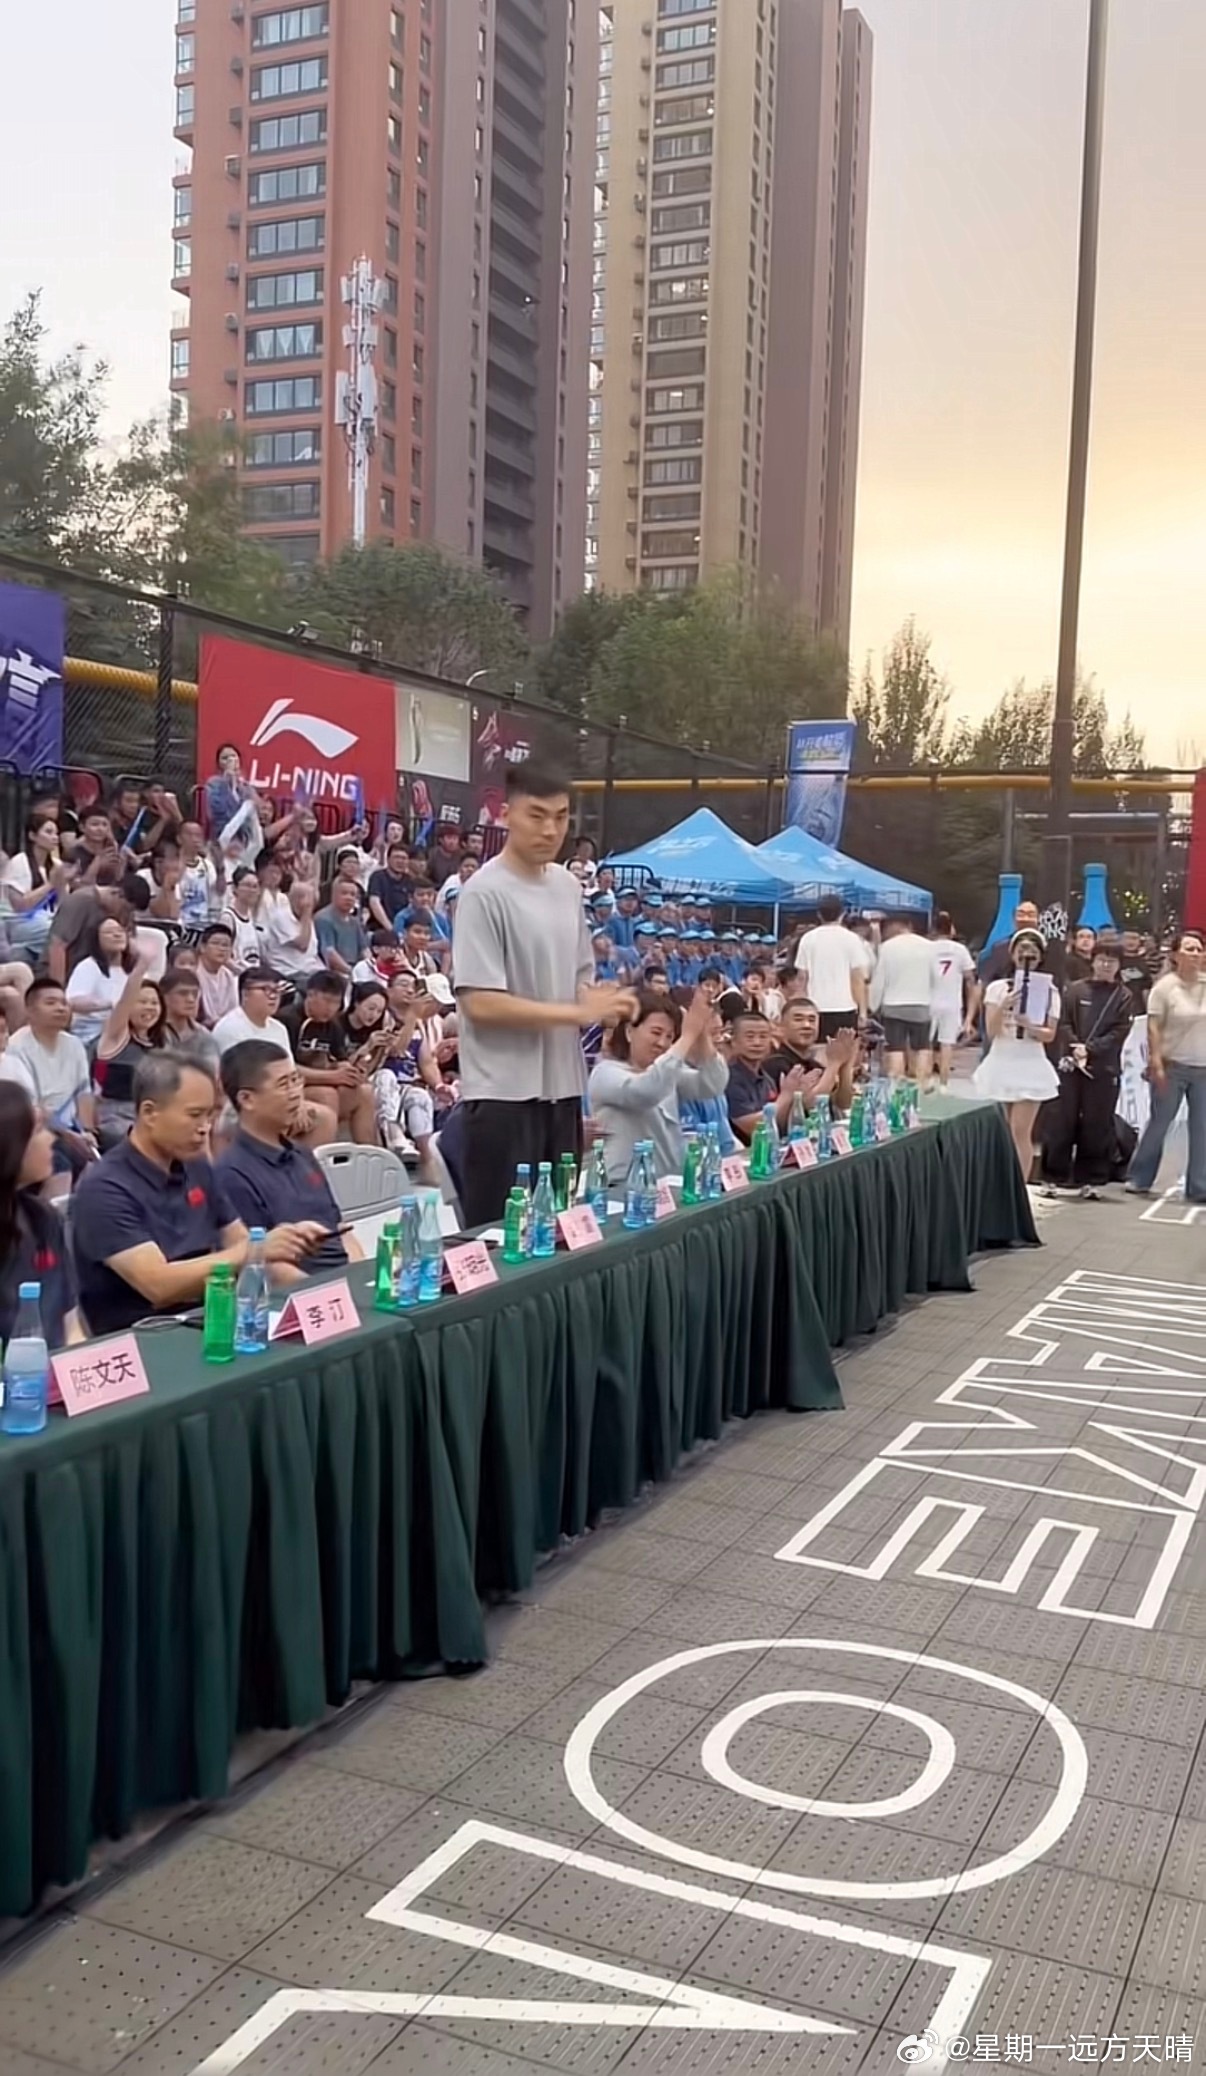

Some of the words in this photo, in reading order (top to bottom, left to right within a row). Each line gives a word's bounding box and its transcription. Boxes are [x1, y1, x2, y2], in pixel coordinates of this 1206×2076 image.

[248, 759, 358, 801] LI-NING
[938, 960, 953, 976] 7
[69, 1352, 136, 1397] 陈文天
